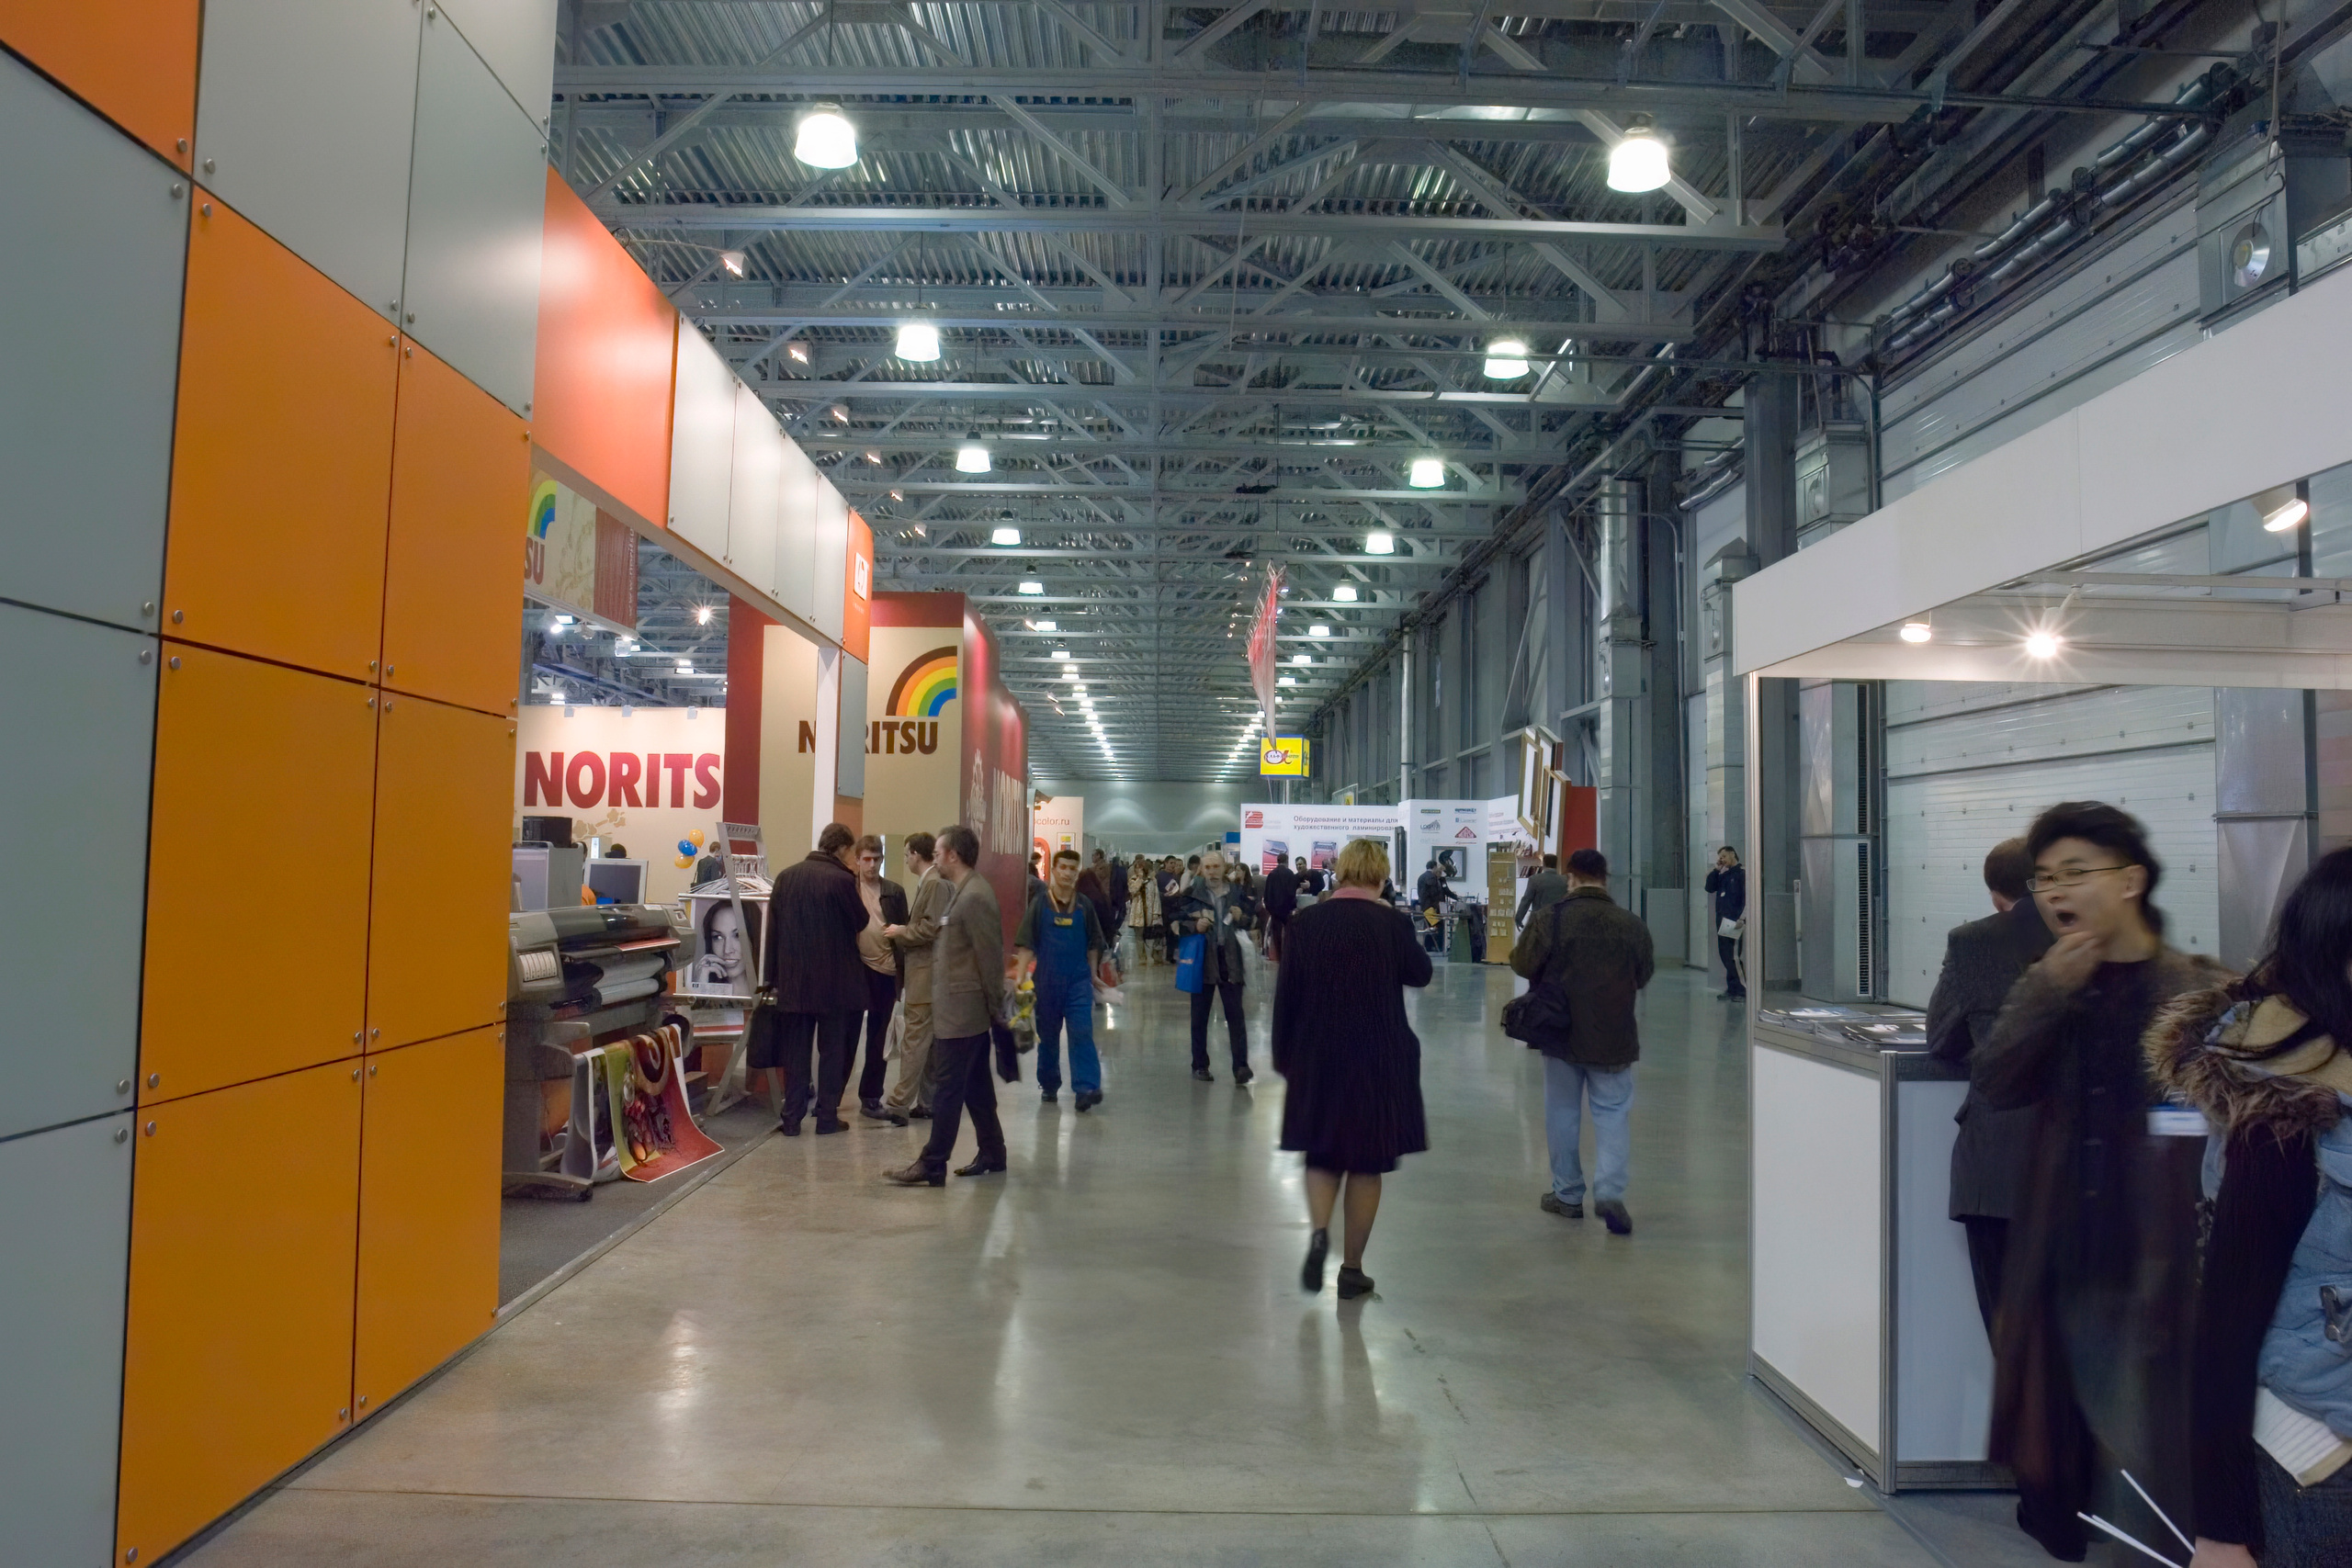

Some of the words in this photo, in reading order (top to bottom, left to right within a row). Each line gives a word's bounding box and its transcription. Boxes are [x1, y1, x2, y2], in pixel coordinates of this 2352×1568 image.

[797, 720, 939, 755] NITSU
[524, 750, 721, 810] NORITS
[1035, 817, 1070, 826] color.ru
[1294, 815, 1340, 823] Оборудование
